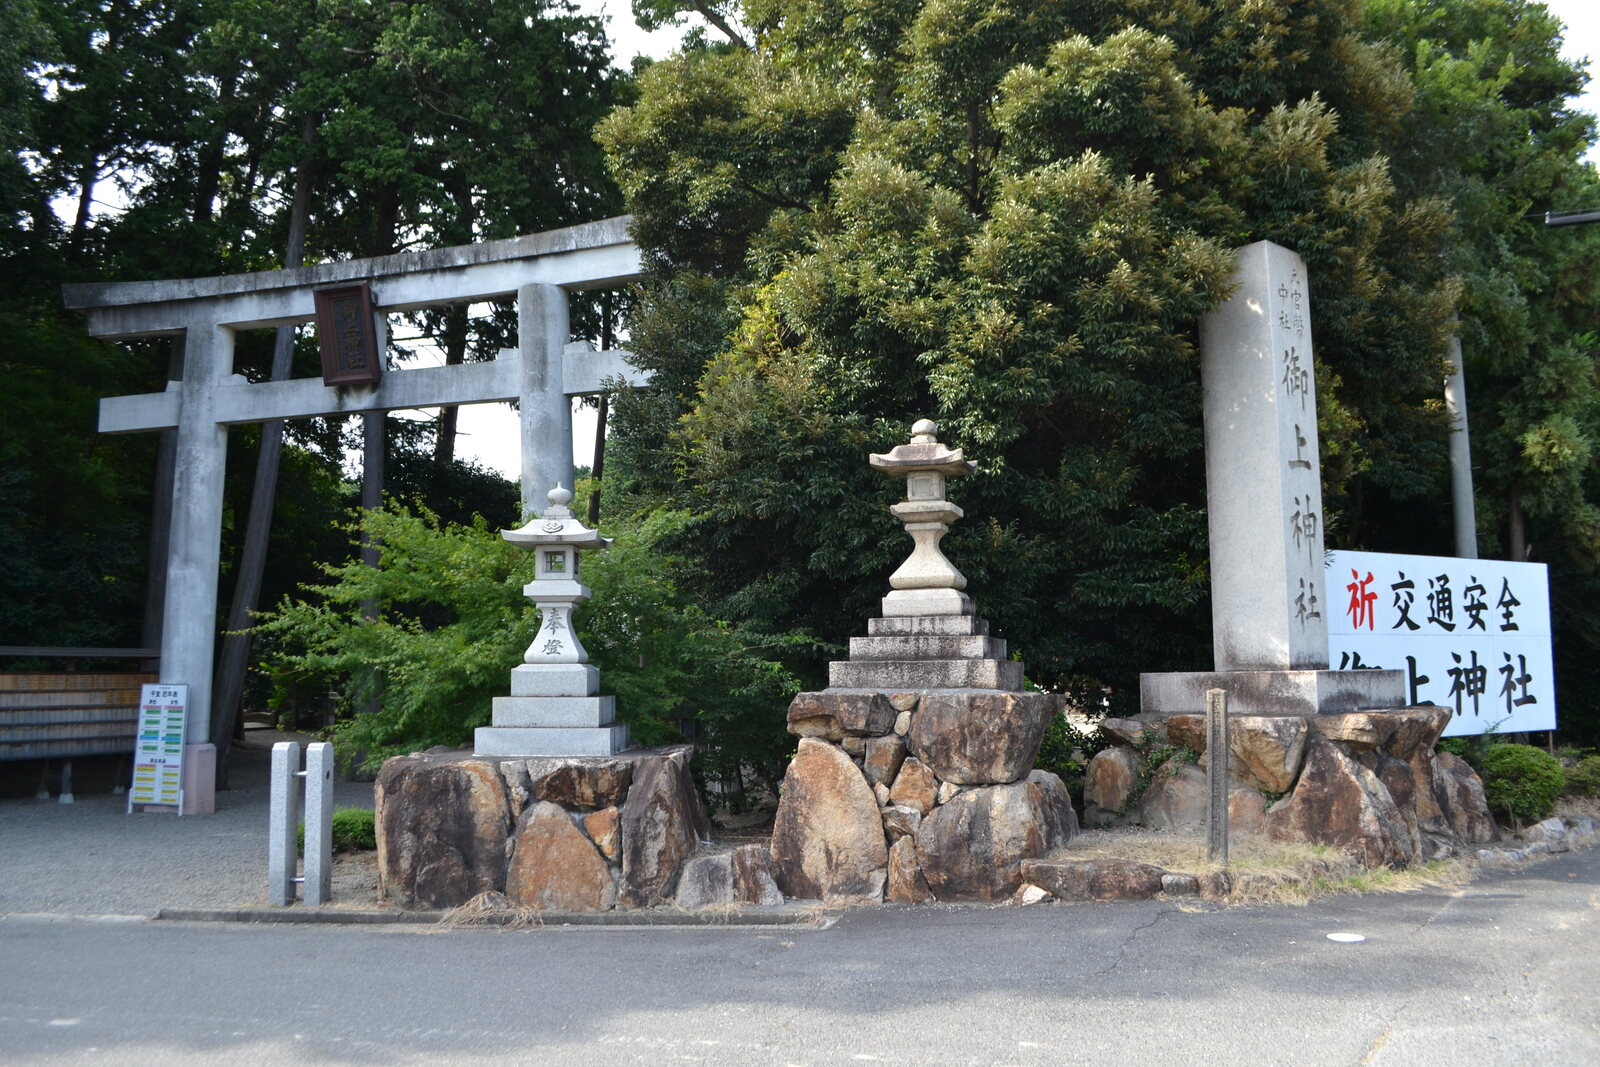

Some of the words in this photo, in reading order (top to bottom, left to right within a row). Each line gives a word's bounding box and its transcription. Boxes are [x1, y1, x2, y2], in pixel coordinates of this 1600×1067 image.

[1281, 346, 1322, 632] 御上神社
[1346, 568, 1521, 632] 祈交通安全
[1339, 650, 1537, 717] 上神社
